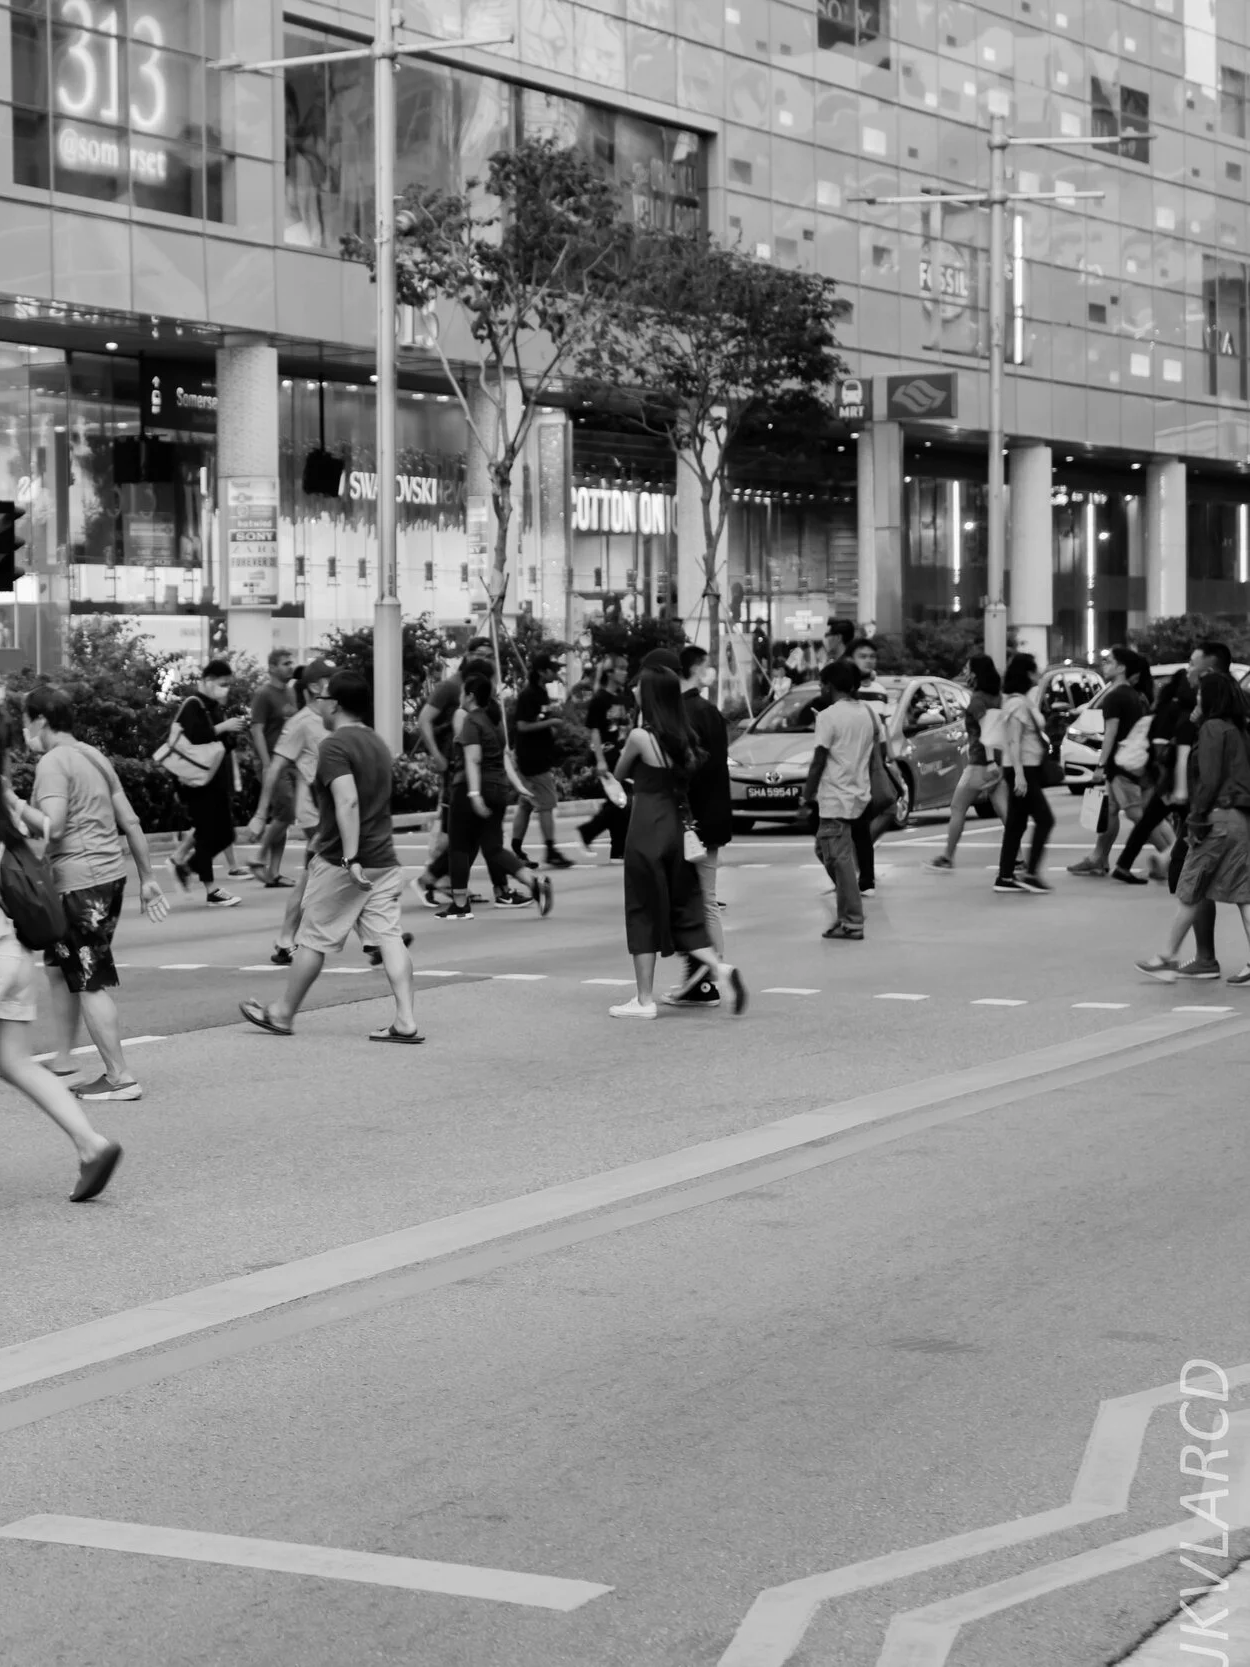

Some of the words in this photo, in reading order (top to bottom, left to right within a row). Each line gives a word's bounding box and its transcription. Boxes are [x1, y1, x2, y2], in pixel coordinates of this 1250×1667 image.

[57, 0, 166, 127] 313
[58, 128, 167, 180] @somrset
[176, 386, 218, 410] Somerse
[838, 405, 865, 419] MRT
[350, 471, 437, 505] SWOVSKI
[639, 491, 666, 535] ON
[236, 531, 273, 541] SONY
